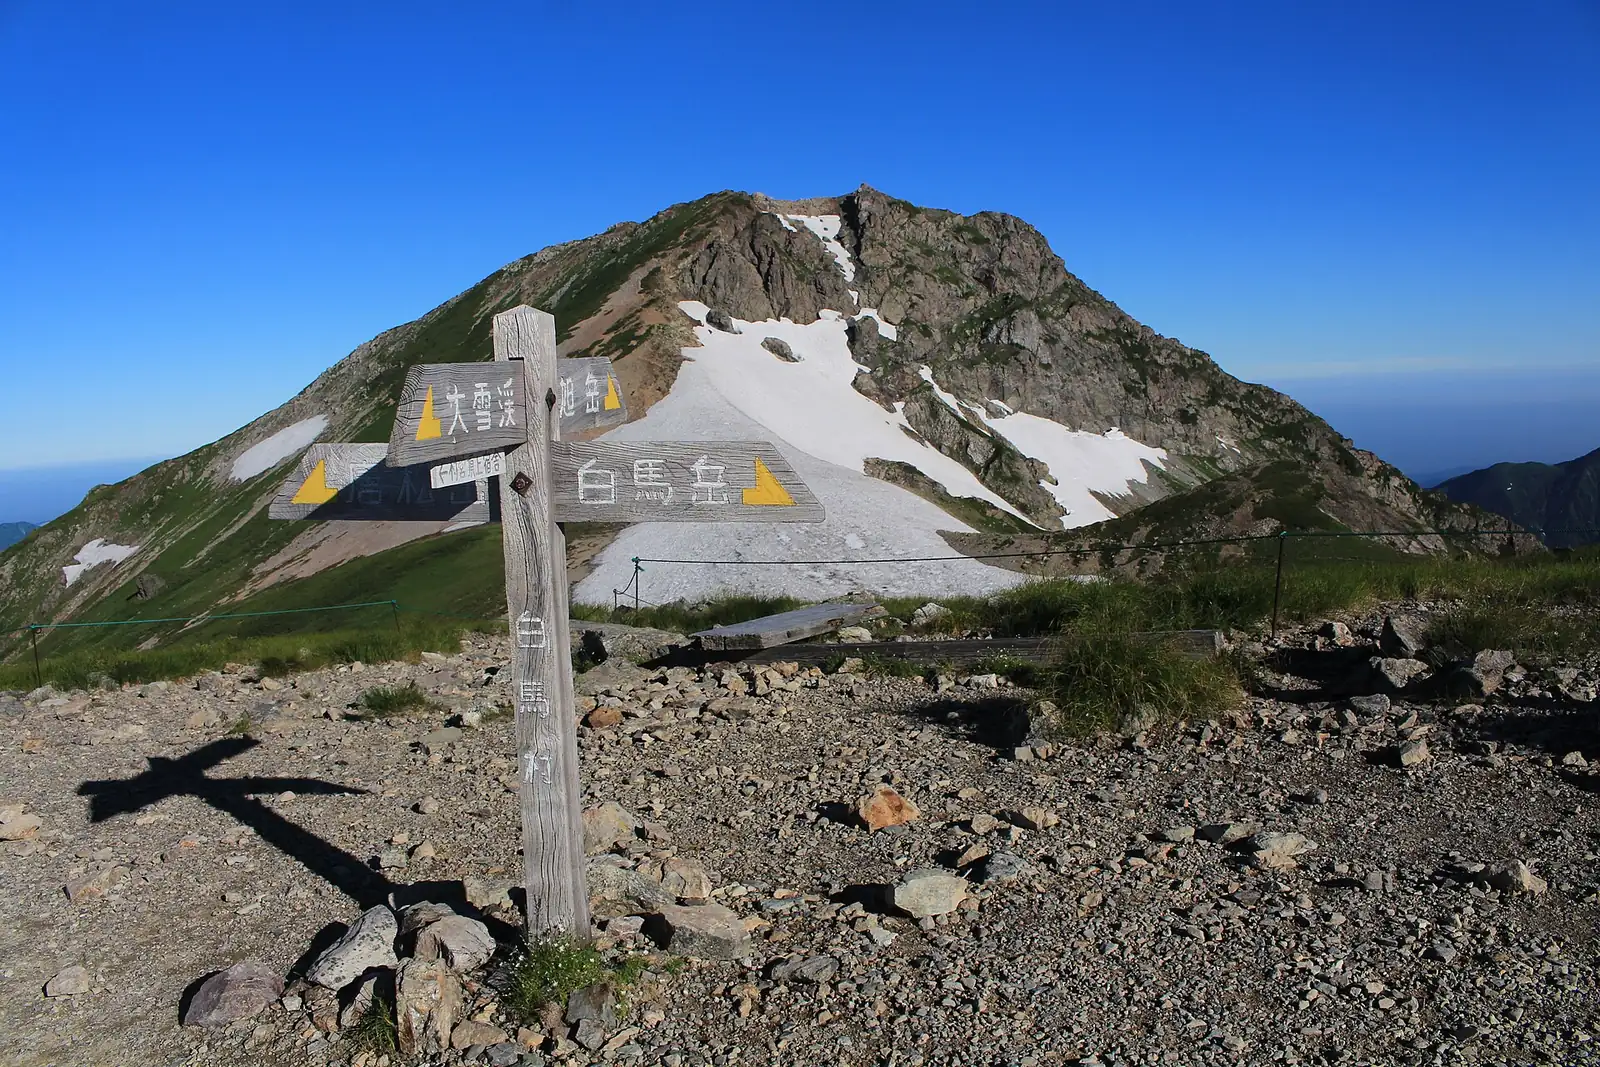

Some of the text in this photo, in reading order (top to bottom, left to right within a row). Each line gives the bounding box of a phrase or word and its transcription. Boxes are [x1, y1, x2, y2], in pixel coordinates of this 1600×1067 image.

[446, 377, 516, 434] 大雪渓
[559, 371, 600, 418] 旭岳
[577, 454, 731, 505] 白馬岳
[516, 609, 551, 784] 白馬村
